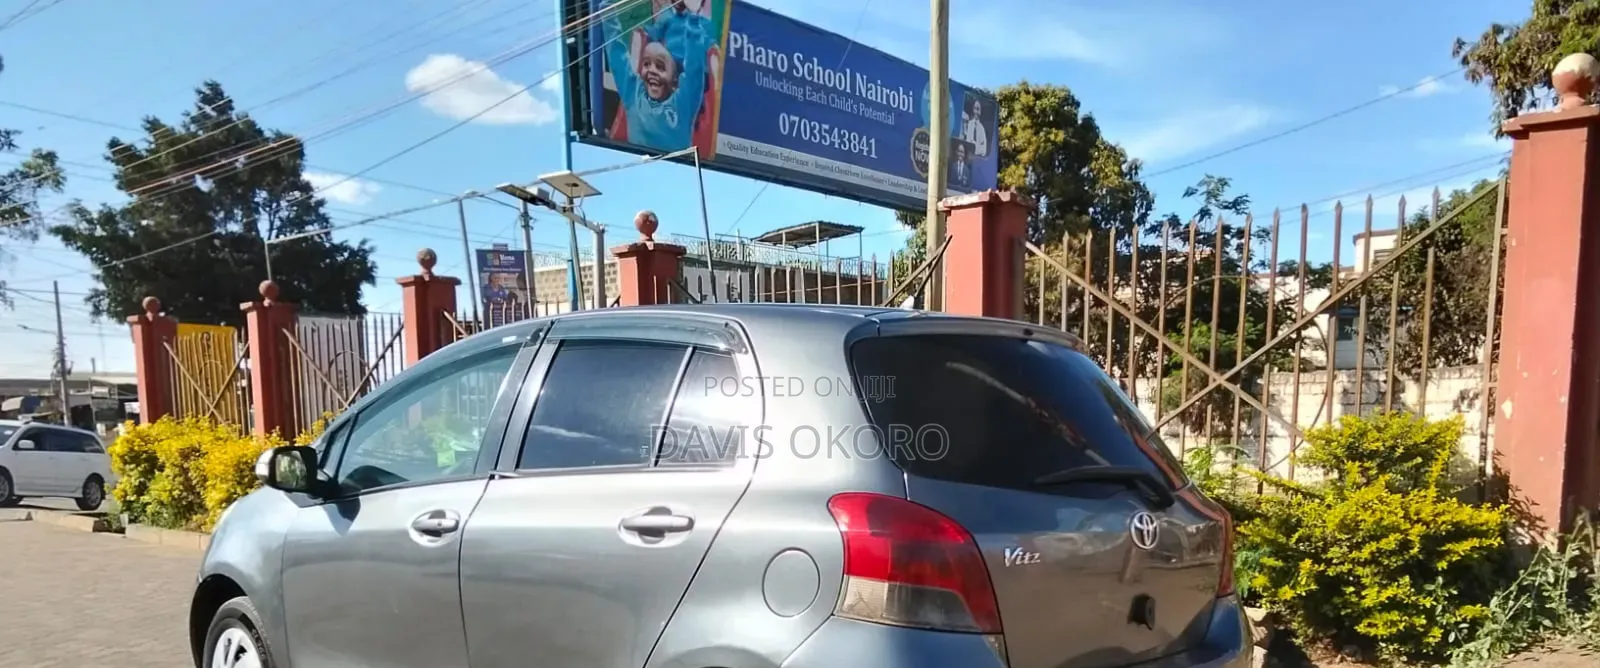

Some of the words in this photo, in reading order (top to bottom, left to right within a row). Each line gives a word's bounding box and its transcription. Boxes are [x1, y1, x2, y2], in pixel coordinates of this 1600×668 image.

[728, 31, 788, 73] Pharo
[793, 52, 850, 93] School
[855, 72, 914, 113] Nairobi
[755, 71, 804, 102] Unlocking
[805, 86, 827, 106] Each
[829, 93, 858, 114] Child's
[859, 104, 895, 125] Potential
[727, 141, 749, 154] Quality
[750, 146, 779, 160] Education
[779, 112, 878, 159] 0703543841
[1004, 547, 1041, 567] Vitz
